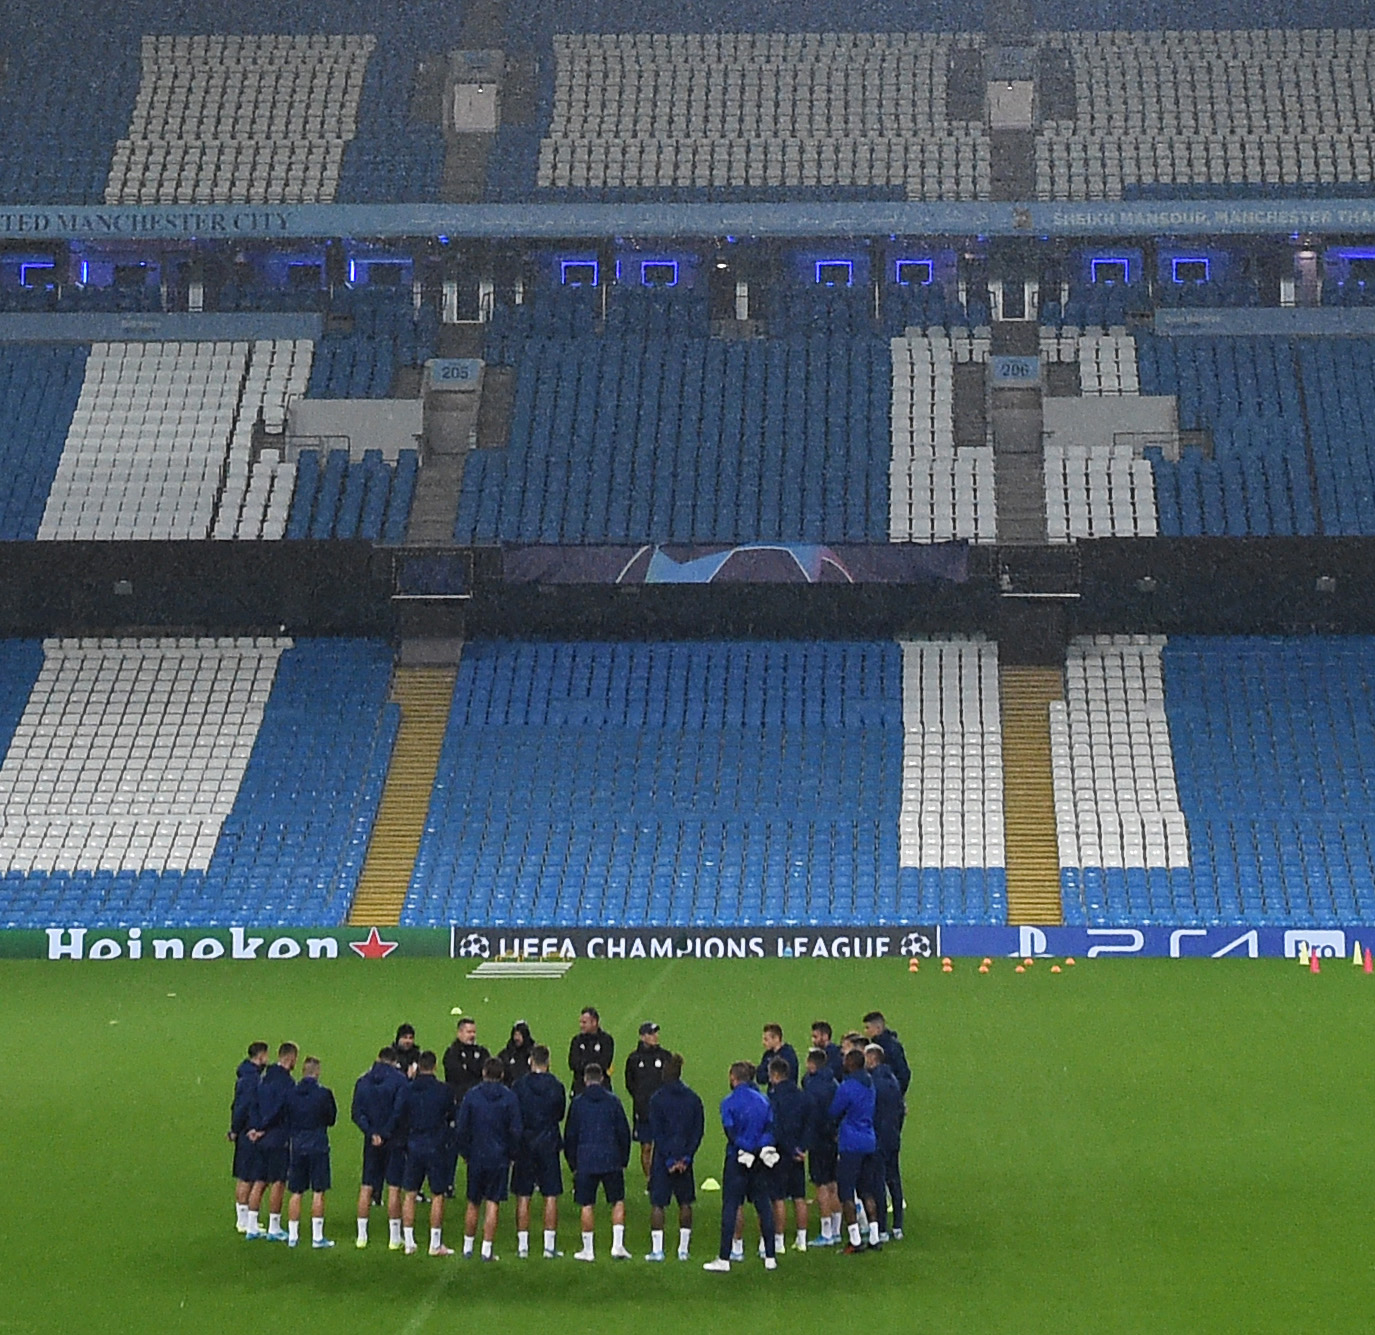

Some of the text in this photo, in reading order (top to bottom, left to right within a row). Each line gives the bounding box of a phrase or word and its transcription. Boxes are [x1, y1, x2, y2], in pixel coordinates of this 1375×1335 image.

[56, 213, 226, 232] MANCHESTER
[232, 211, 292, 231] CITY
[1215, 209, 1331, 225] MANCHESTER
[440, 366, 469, 380] 205
[45, 927, 339, 960] Heineken
